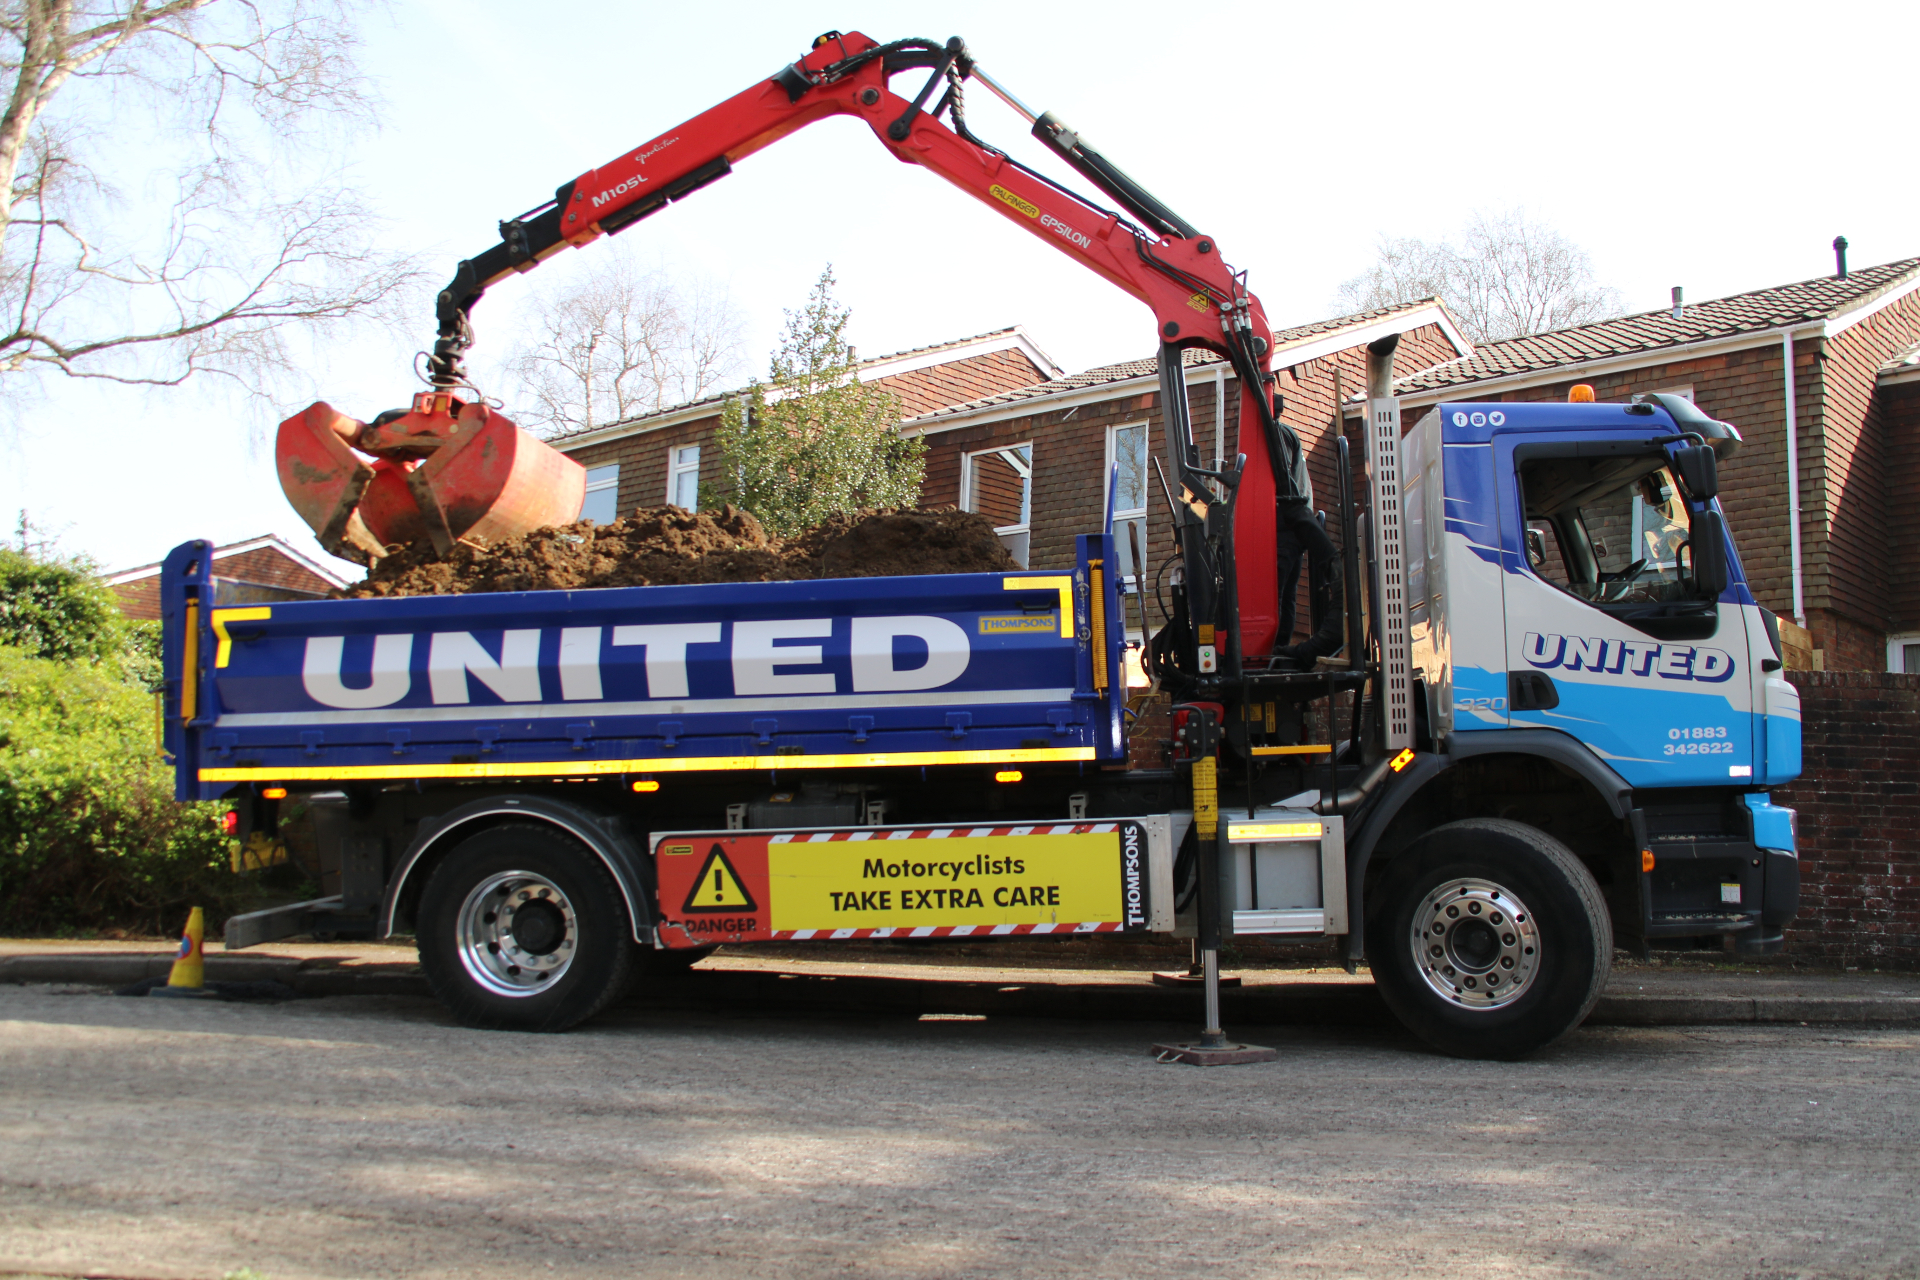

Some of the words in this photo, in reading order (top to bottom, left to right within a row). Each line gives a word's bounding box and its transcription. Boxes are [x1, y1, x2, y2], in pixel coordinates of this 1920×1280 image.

[592, 174, 648, 207] M105L
[993, 186, 1037, 216] PALFINGER
[1040, 214, 1091, 249] EPSILON
[982, 618, 1054, 631] THOMPSONS
[303, 615, 970, 709] UNITED
[1522, 632, 1735, 683] UNITED
[1458, 697, 1507, 711] 320
[1668, 727, 1728, 740] 01883
[1663, 742, 1734, 756] 342622
[863, 854, 1025, 882] Motorcyclists
[1125, 825, 1145, 927] THOMPSONS
[830, 891, 892, 912] TAKE
[901, 888, 984, 910] EXTRA
[993, 886, 1061, 908] CARE
[685, 917, 757, 933] DANGER
